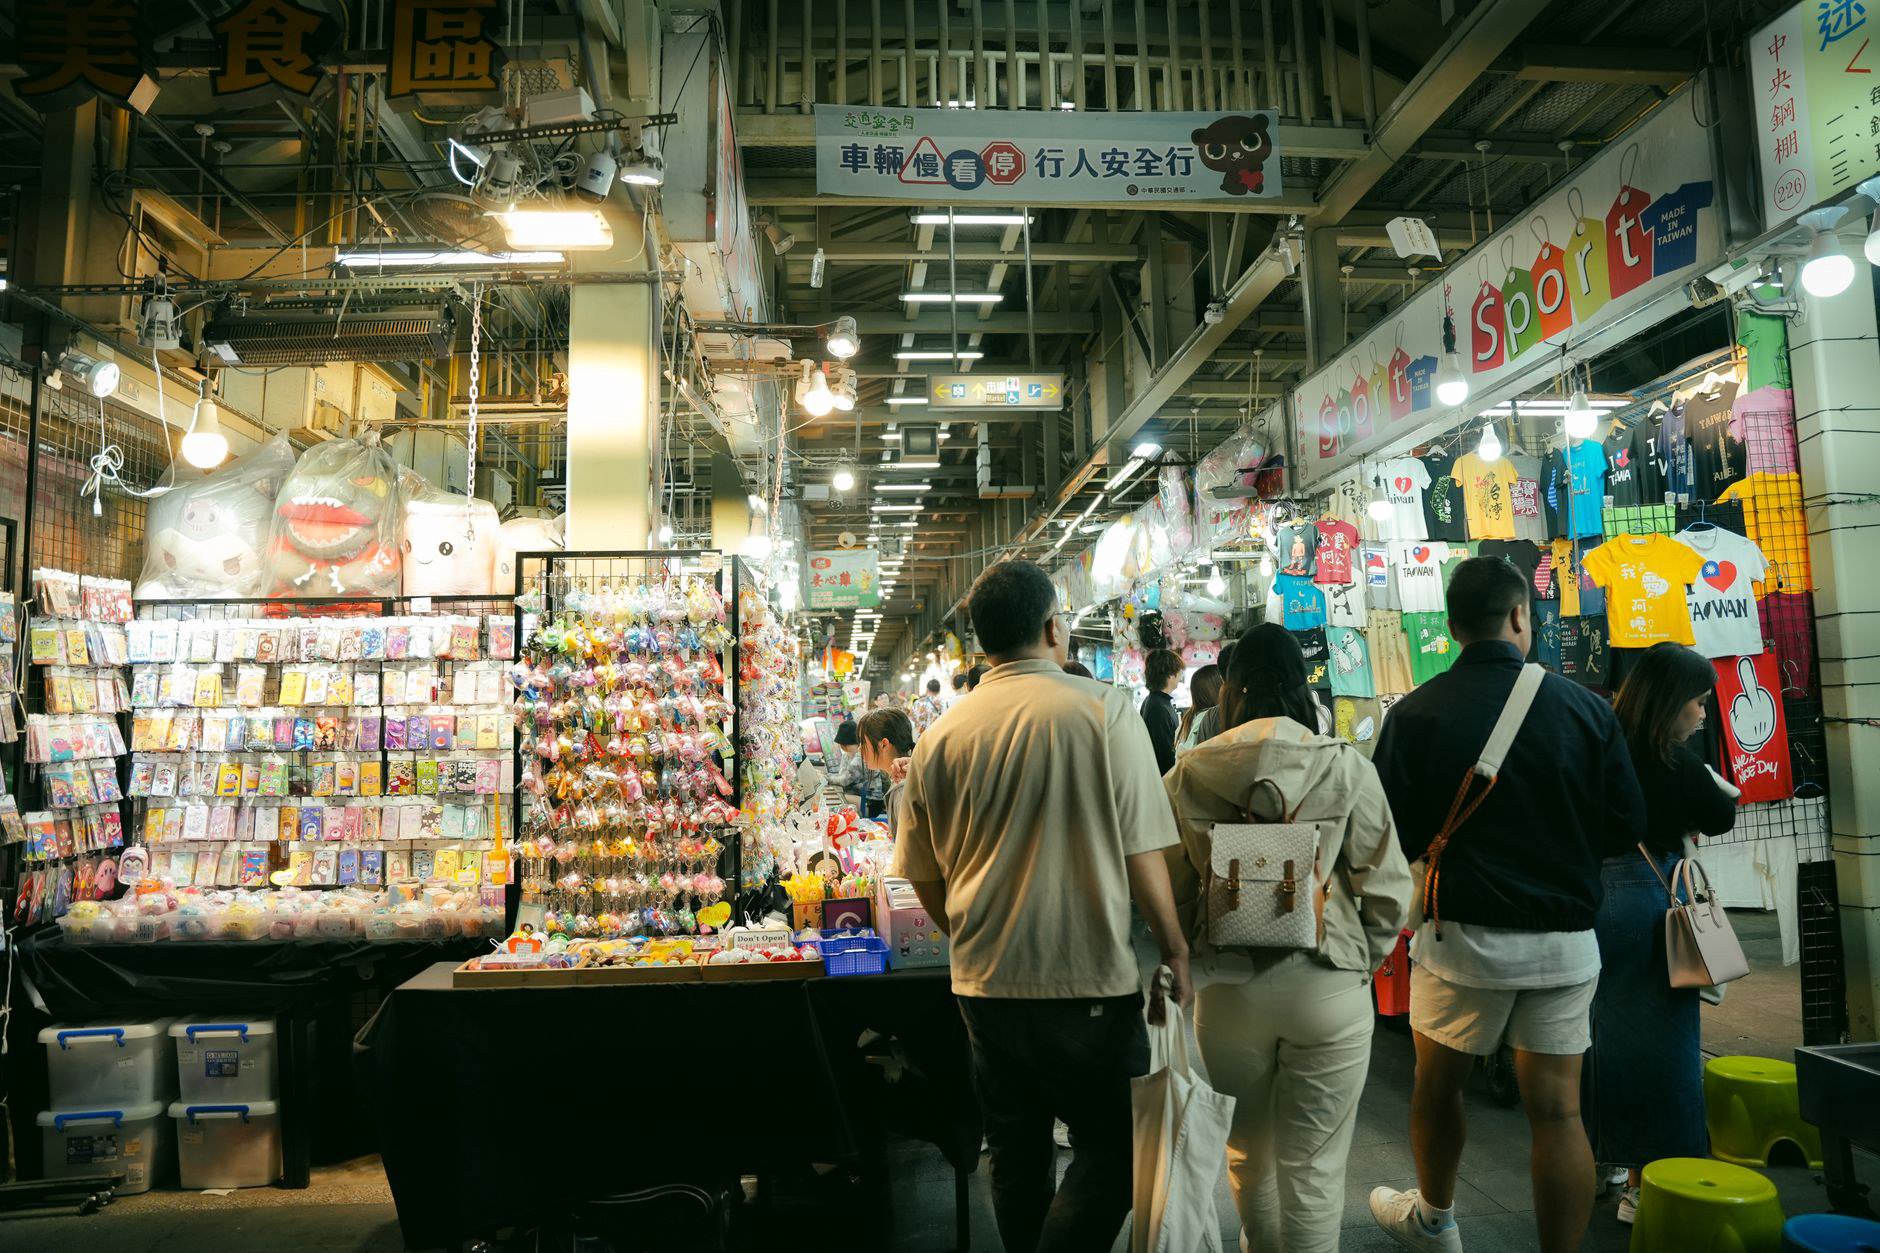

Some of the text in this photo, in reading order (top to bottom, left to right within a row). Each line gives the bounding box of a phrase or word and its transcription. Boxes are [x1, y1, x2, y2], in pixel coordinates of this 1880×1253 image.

[19, 0, 498, 97] 美食區
[1767, 34, 1799, 165] 中央鋼棚
[1034, 146, 1195, 179] 行人安全行
[1777, 177, 1802, 204] 226
[1660, 206, 1686, 223] MADE
[1656, 225, 1693, 246] TAIWAN
[1667, 220, 1678, 231] IN
[1476, 214, 1640, 361] Sport
[1414, 368, 1426, 378] MADE
[1417, 377, 1424, 385] IN
[1412, 382, 1430, 394] TAIWAN
[1321, 366, 1405, 452] Sport
[1403, 550, 1409, 564] I
[1756, 760, 1778, 780] DAY
[737, 934, 786, 943] Don't Open!
